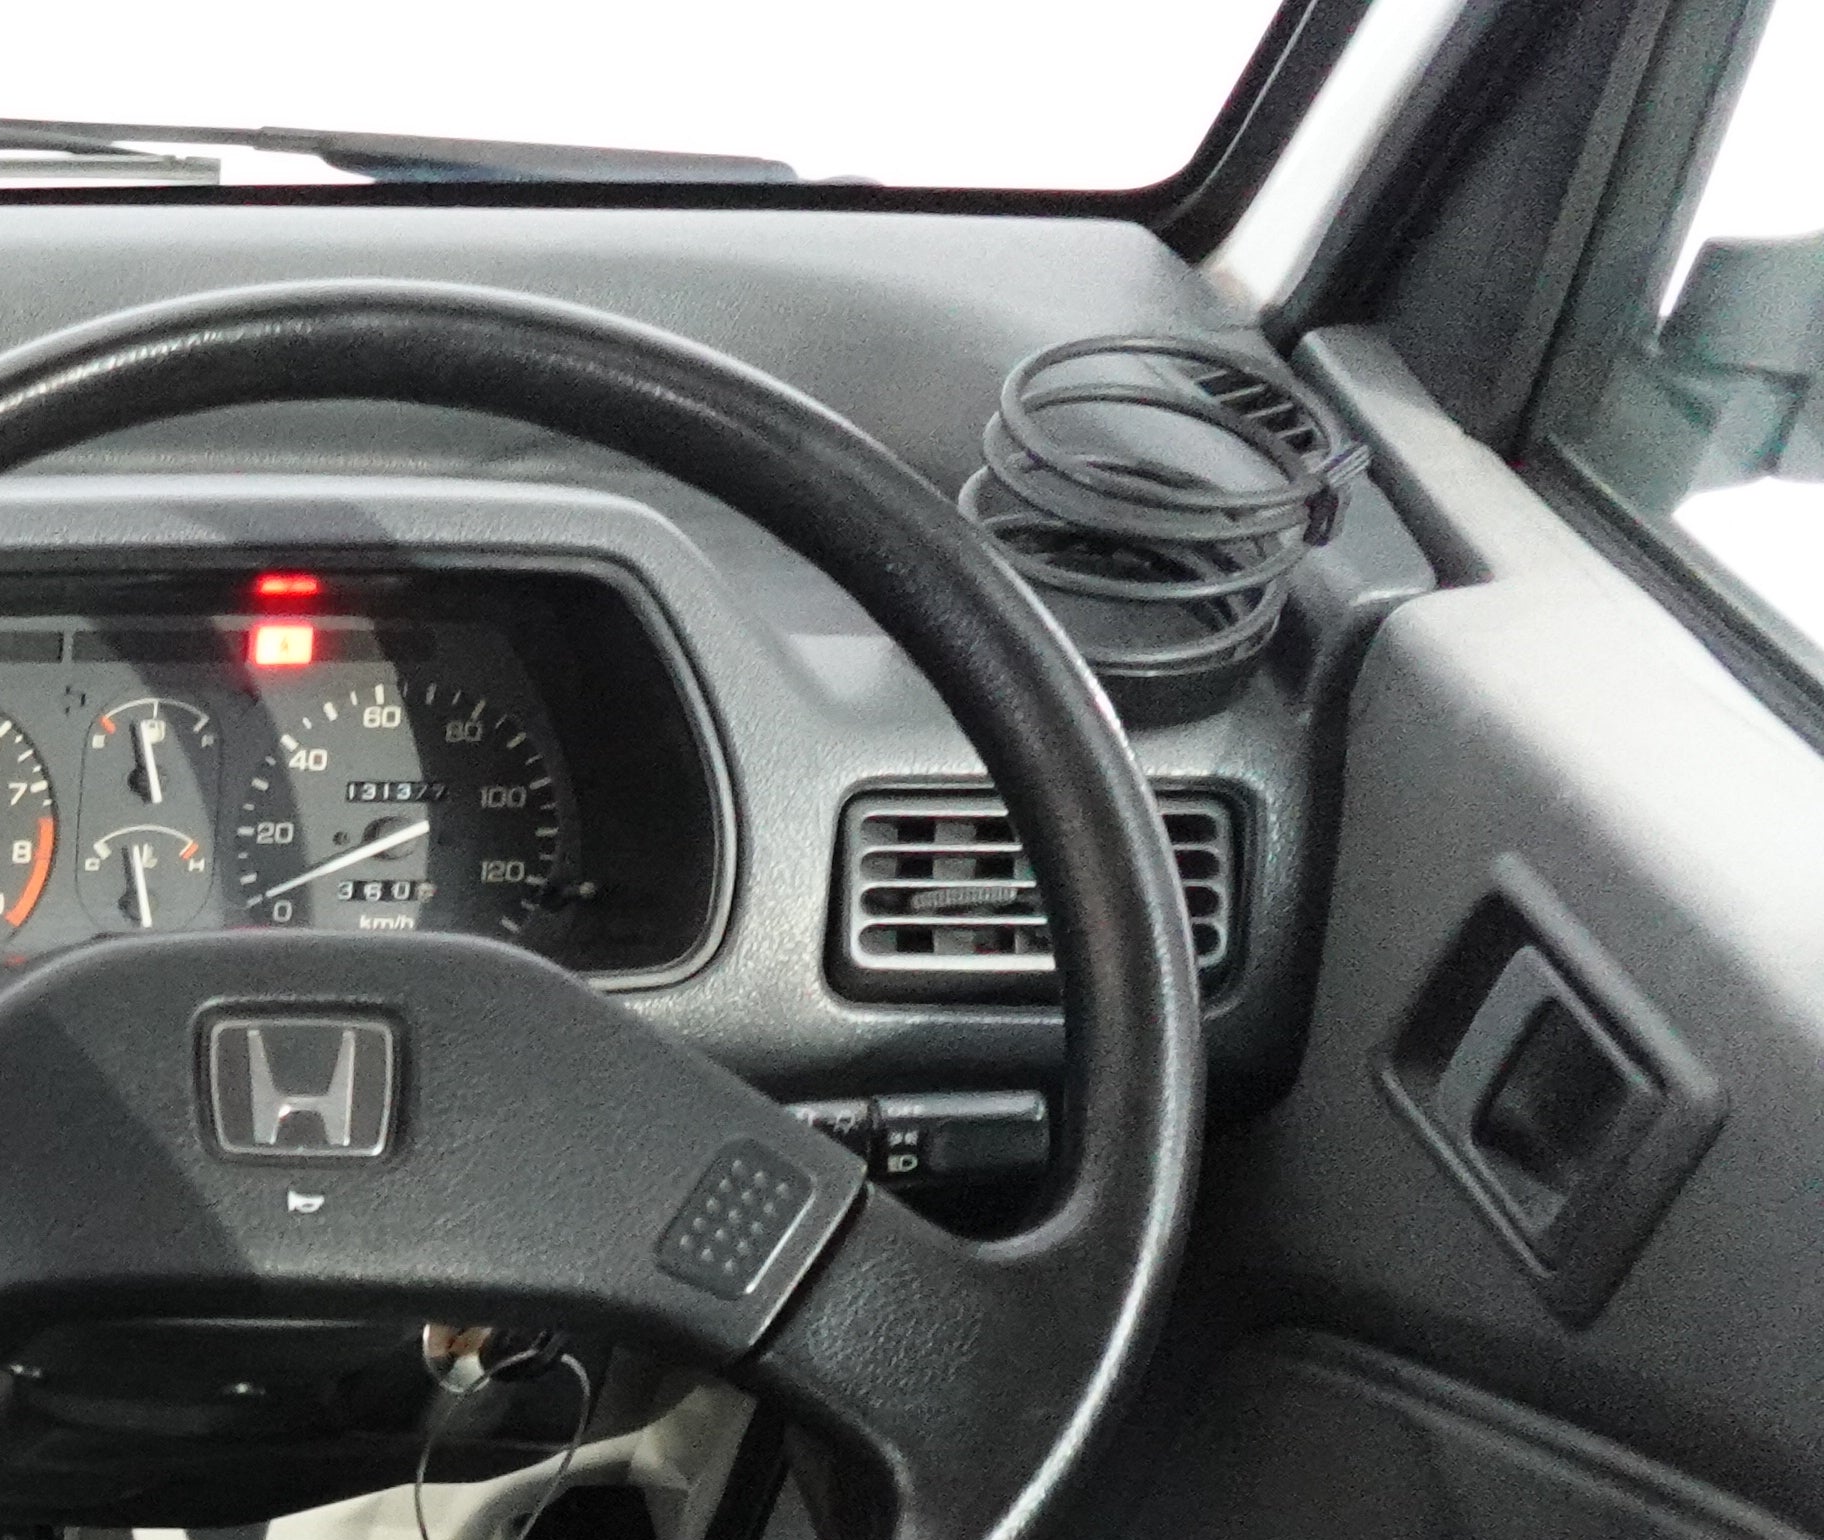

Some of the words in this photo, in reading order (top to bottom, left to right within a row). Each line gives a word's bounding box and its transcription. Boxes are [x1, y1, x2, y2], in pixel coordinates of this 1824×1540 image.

[363, 705, 402, 728] 60
[445, 720, 484, 742] 80
[288, 749, 328, 771] 40
[8, 782, 29, 806] 7
[480, 786, 527, 808] 100
[256, 822, 295, 844] 20
[12, 840, 32, 864] 8
[189, 858, 205, 872] H
[480, 861, 526, 883] 120
[272, 901, 293, 922] 0
[359, 914, 415, 930] km/h
